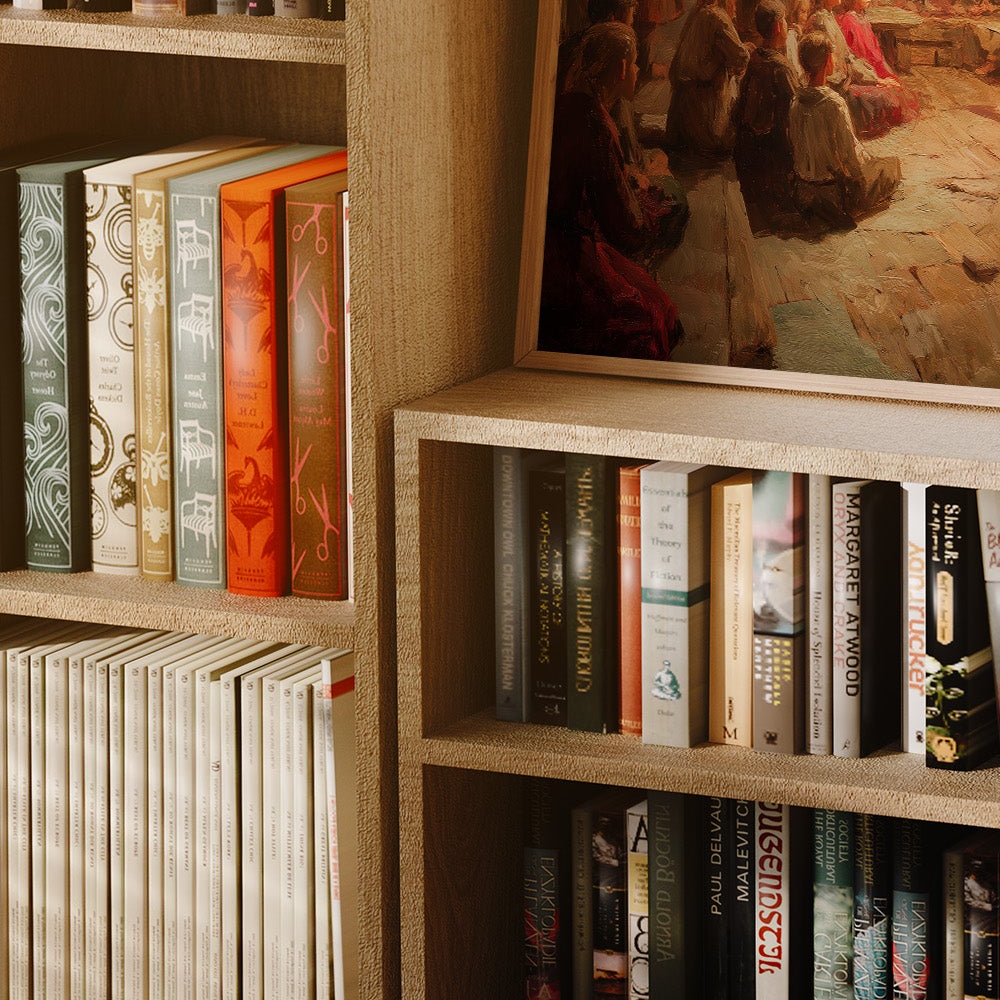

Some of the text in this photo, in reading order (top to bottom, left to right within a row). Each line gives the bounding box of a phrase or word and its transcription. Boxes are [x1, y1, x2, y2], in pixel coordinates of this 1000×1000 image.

[651, 539, 683, 554] Theory
[834, 491, 846, 546] ORYX
[651, 571, 683, 586] Fiction
[846, 492, 862, 697] MARGARET ATWOOD
[834, 601, 846, 671] CRAKE
[710, 797, 722, 915] PAUL DELVAU
